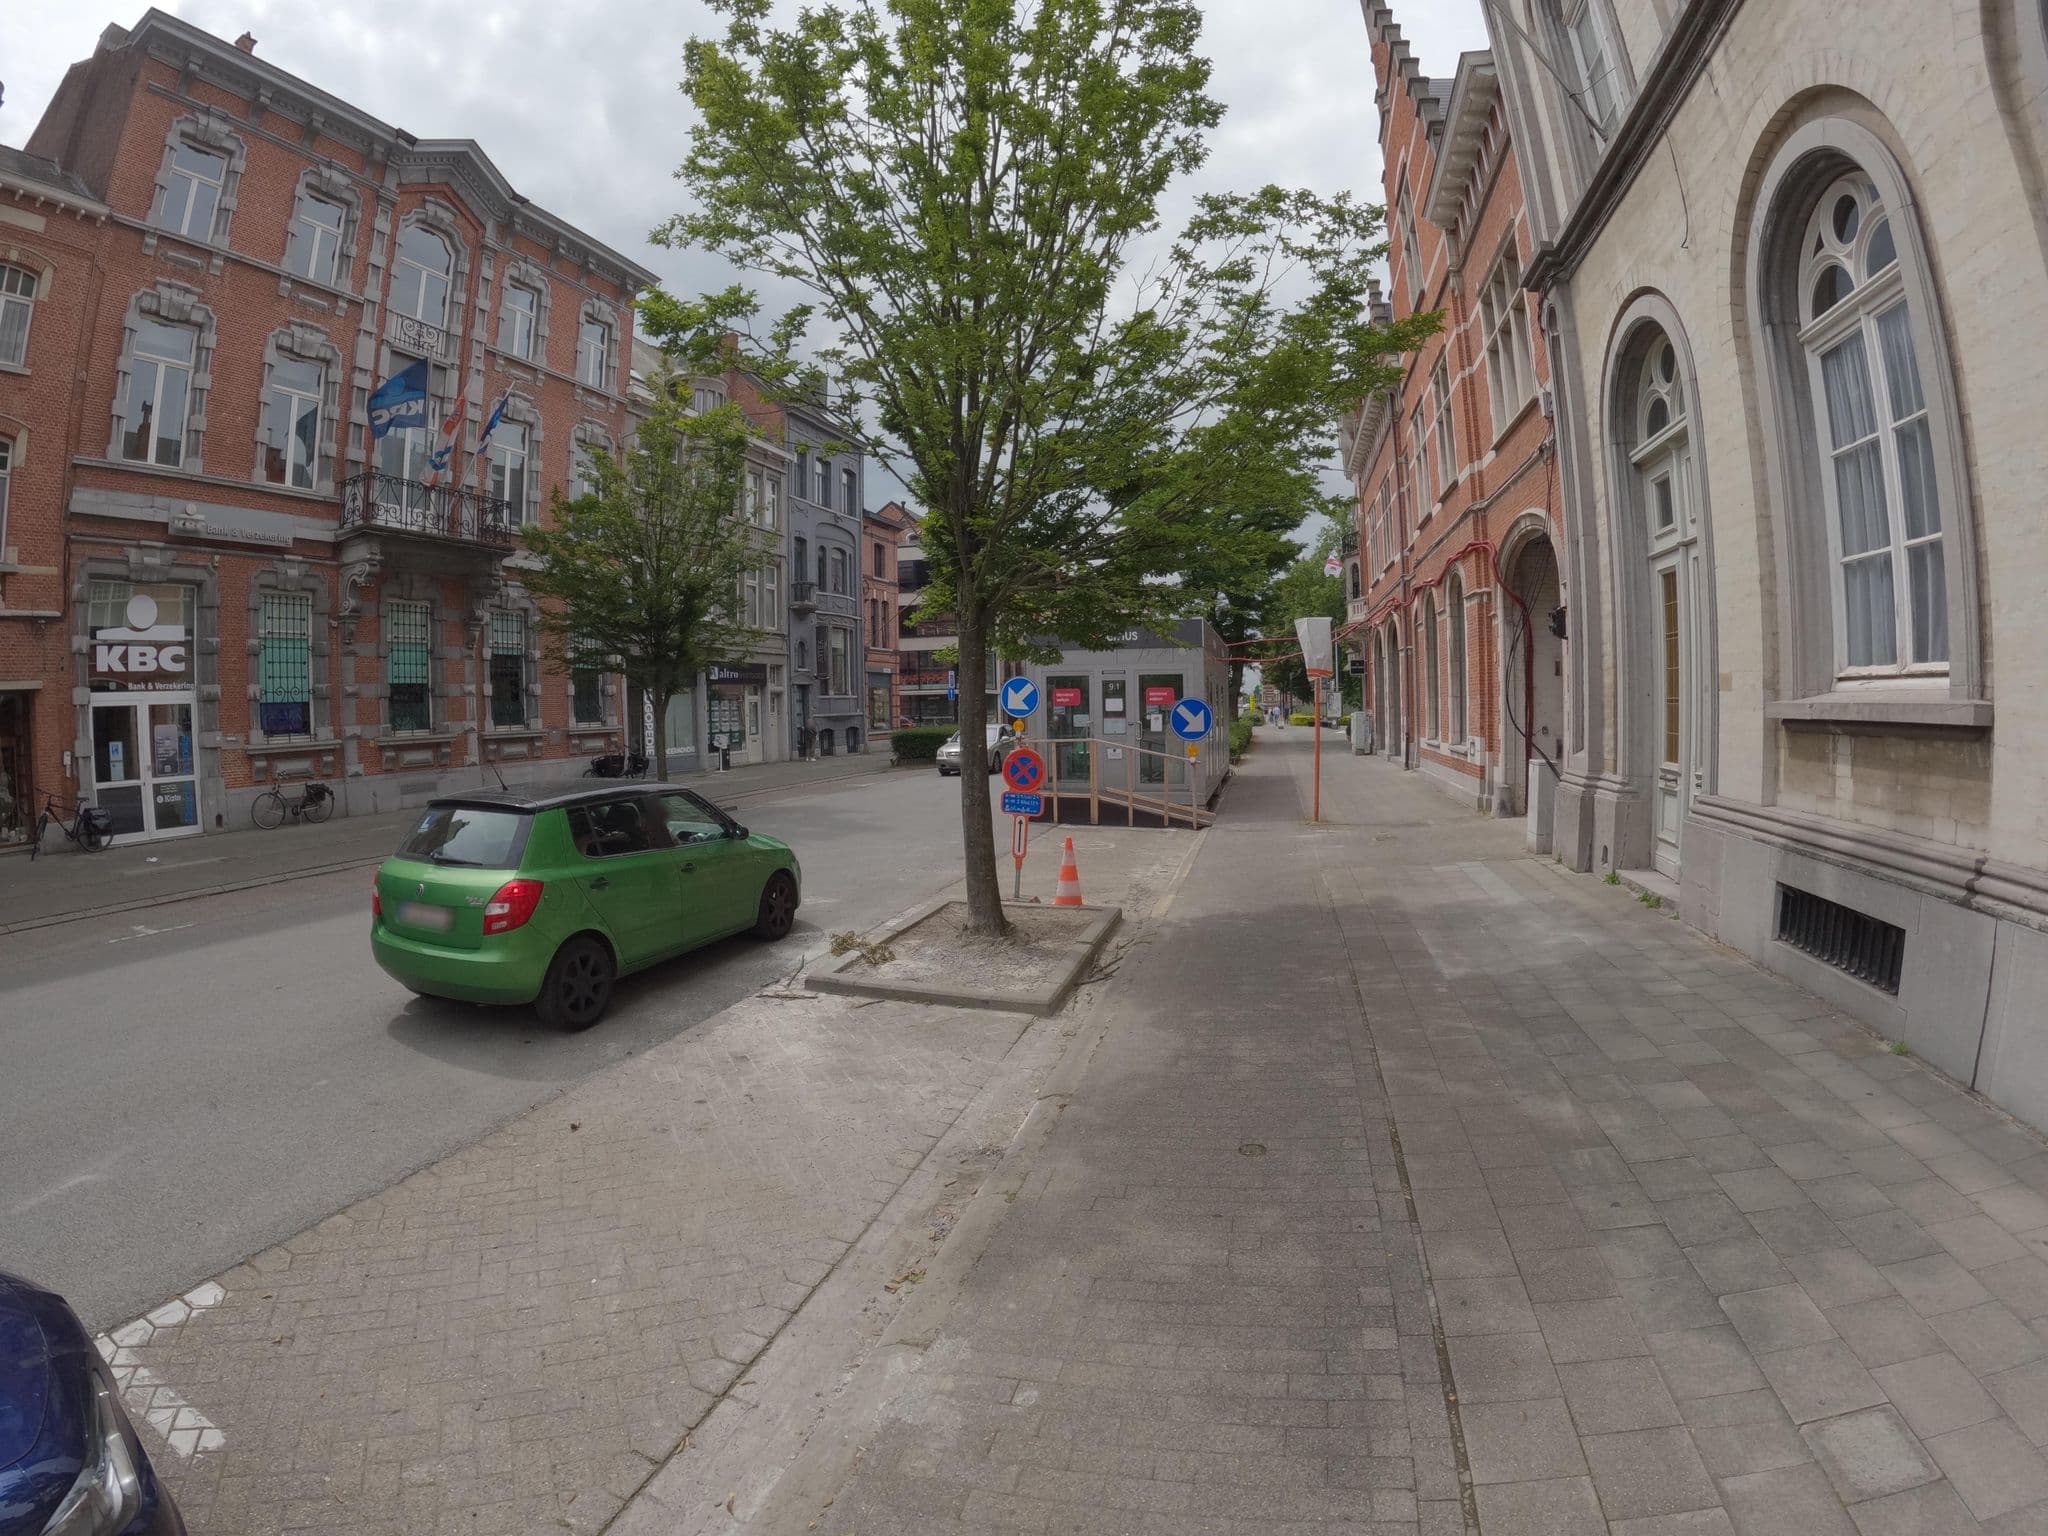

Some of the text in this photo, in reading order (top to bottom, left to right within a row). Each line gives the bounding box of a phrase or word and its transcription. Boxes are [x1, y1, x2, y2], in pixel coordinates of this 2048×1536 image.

[207, 525, 228, 537] Bank
[96, 645, 185, 672] KBC
[128, 681, 195, 691] Bank & Verzekering
